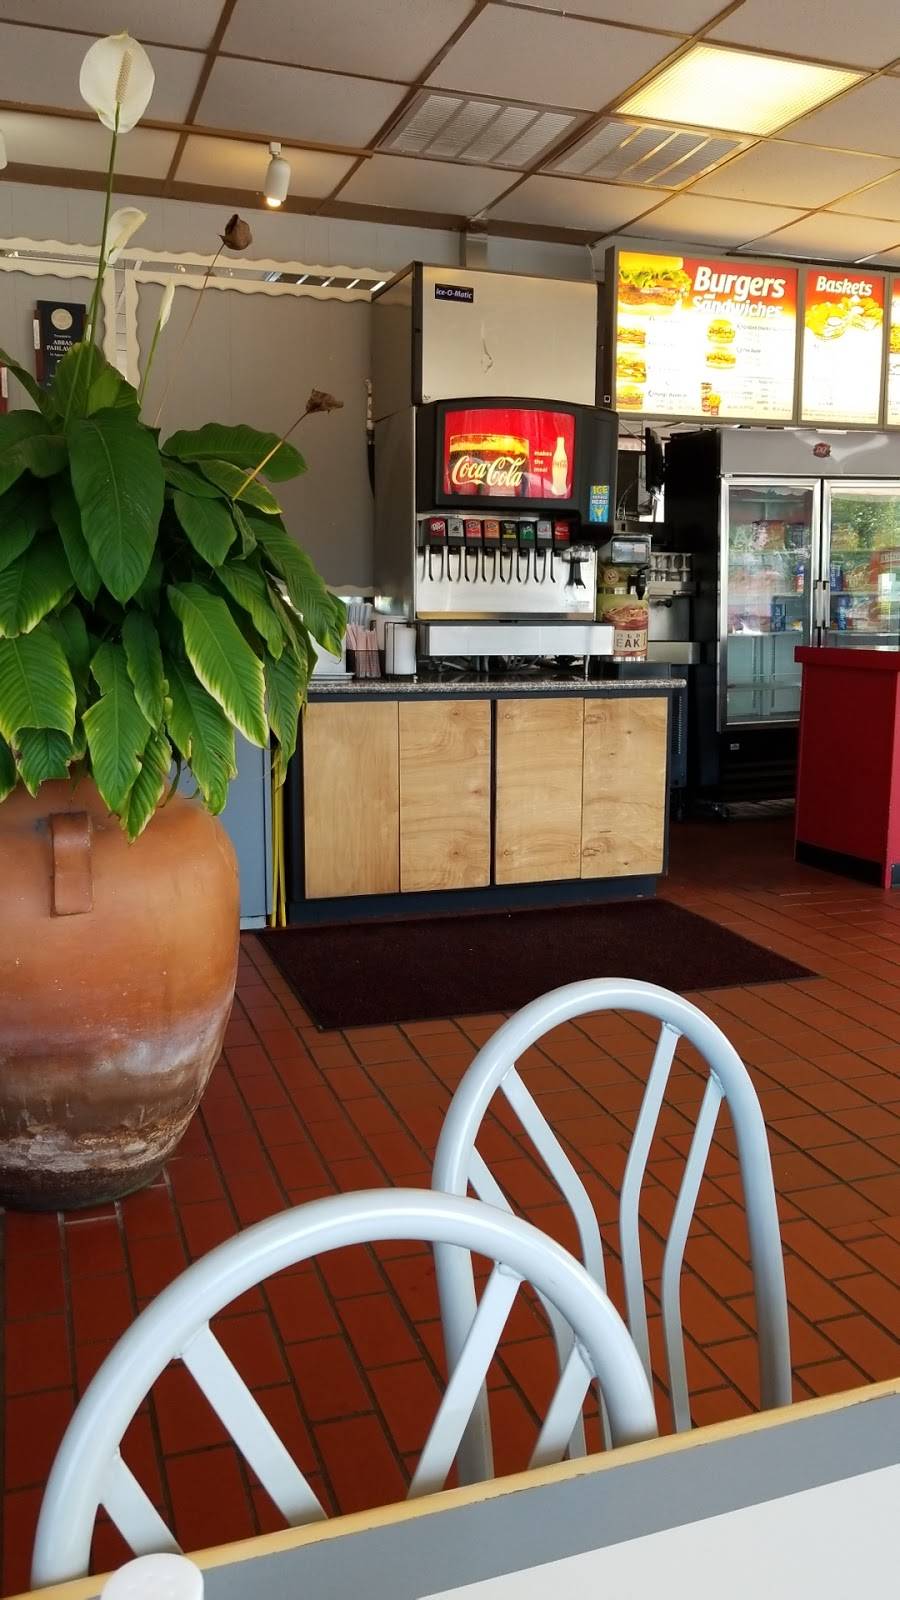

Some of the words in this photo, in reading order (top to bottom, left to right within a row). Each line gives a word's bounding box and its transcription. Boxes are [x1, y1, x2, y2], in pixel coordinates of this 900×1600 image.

[436, 288, 472, 299] Ice-O-Matic
[694, 267, 785, 301] Burgers
[817, 276, 872, 296] Baskets
[693, 296, 783, 317] Sandwiches
[451, 455, 526, 488] Coca-Cola
[616, 639, 641, 648] EAK
